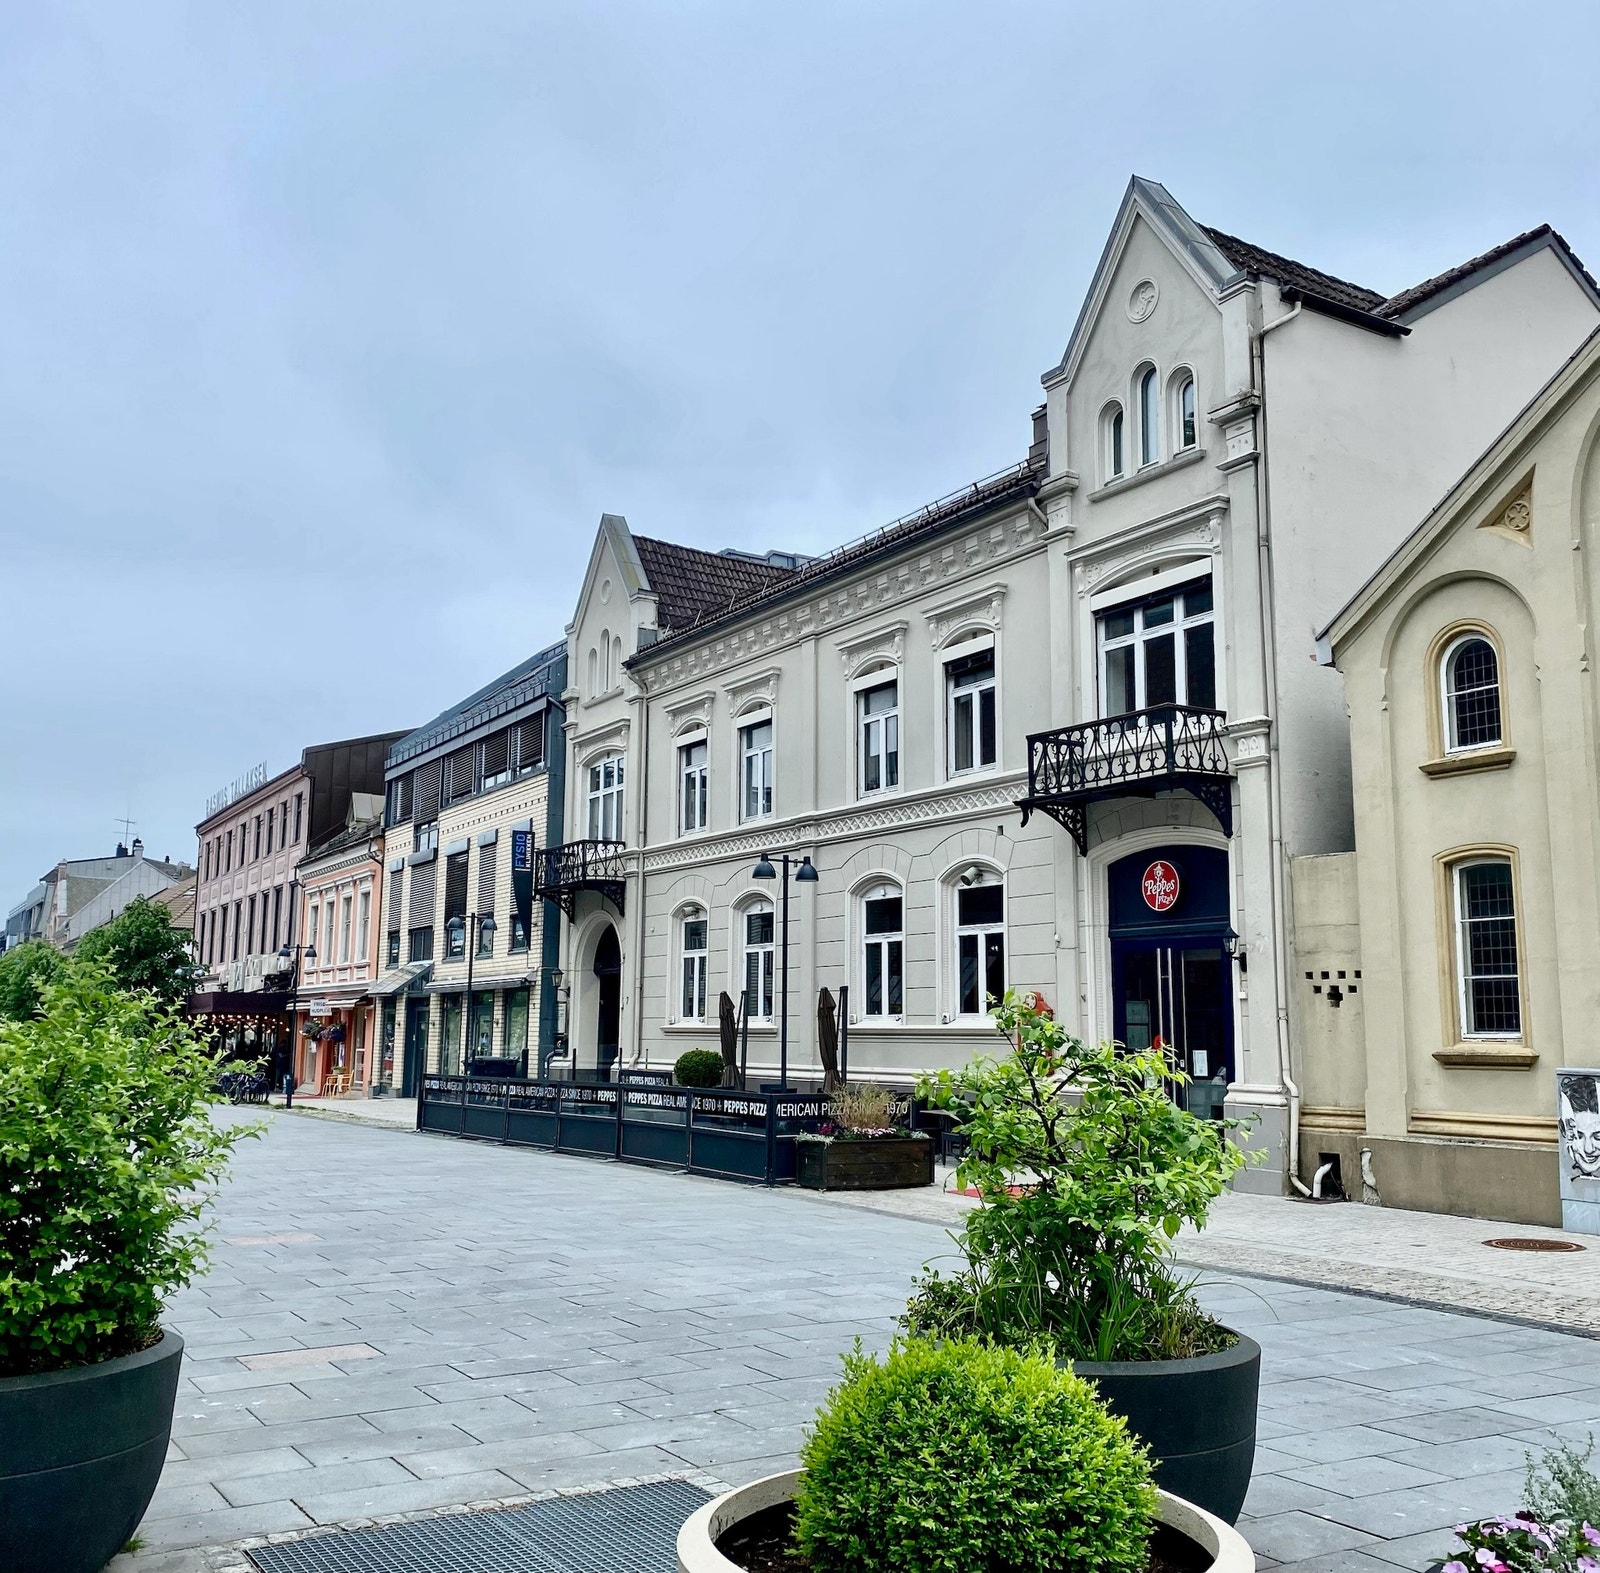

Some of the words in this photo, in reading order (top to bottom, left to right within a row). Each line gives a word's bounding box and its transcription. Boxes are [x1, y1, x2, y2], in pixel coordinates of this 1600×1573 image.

[515, 834, 526, 868] FYSIO
[1145, 878, 1175, 896] Peppes
[644, 1076, 656, 1086] PIZZA
[597, 1090, 617, 1103] PEPPES
[628, 1091, 648, 1106] PEPPES
[648, 1093, 663, 1107] PIZZA
[663, 1094, 676, 1108] REAL
[702, 1097, 716, 1112] 1970
[723, 1099, 748, 1115] PEPPES
